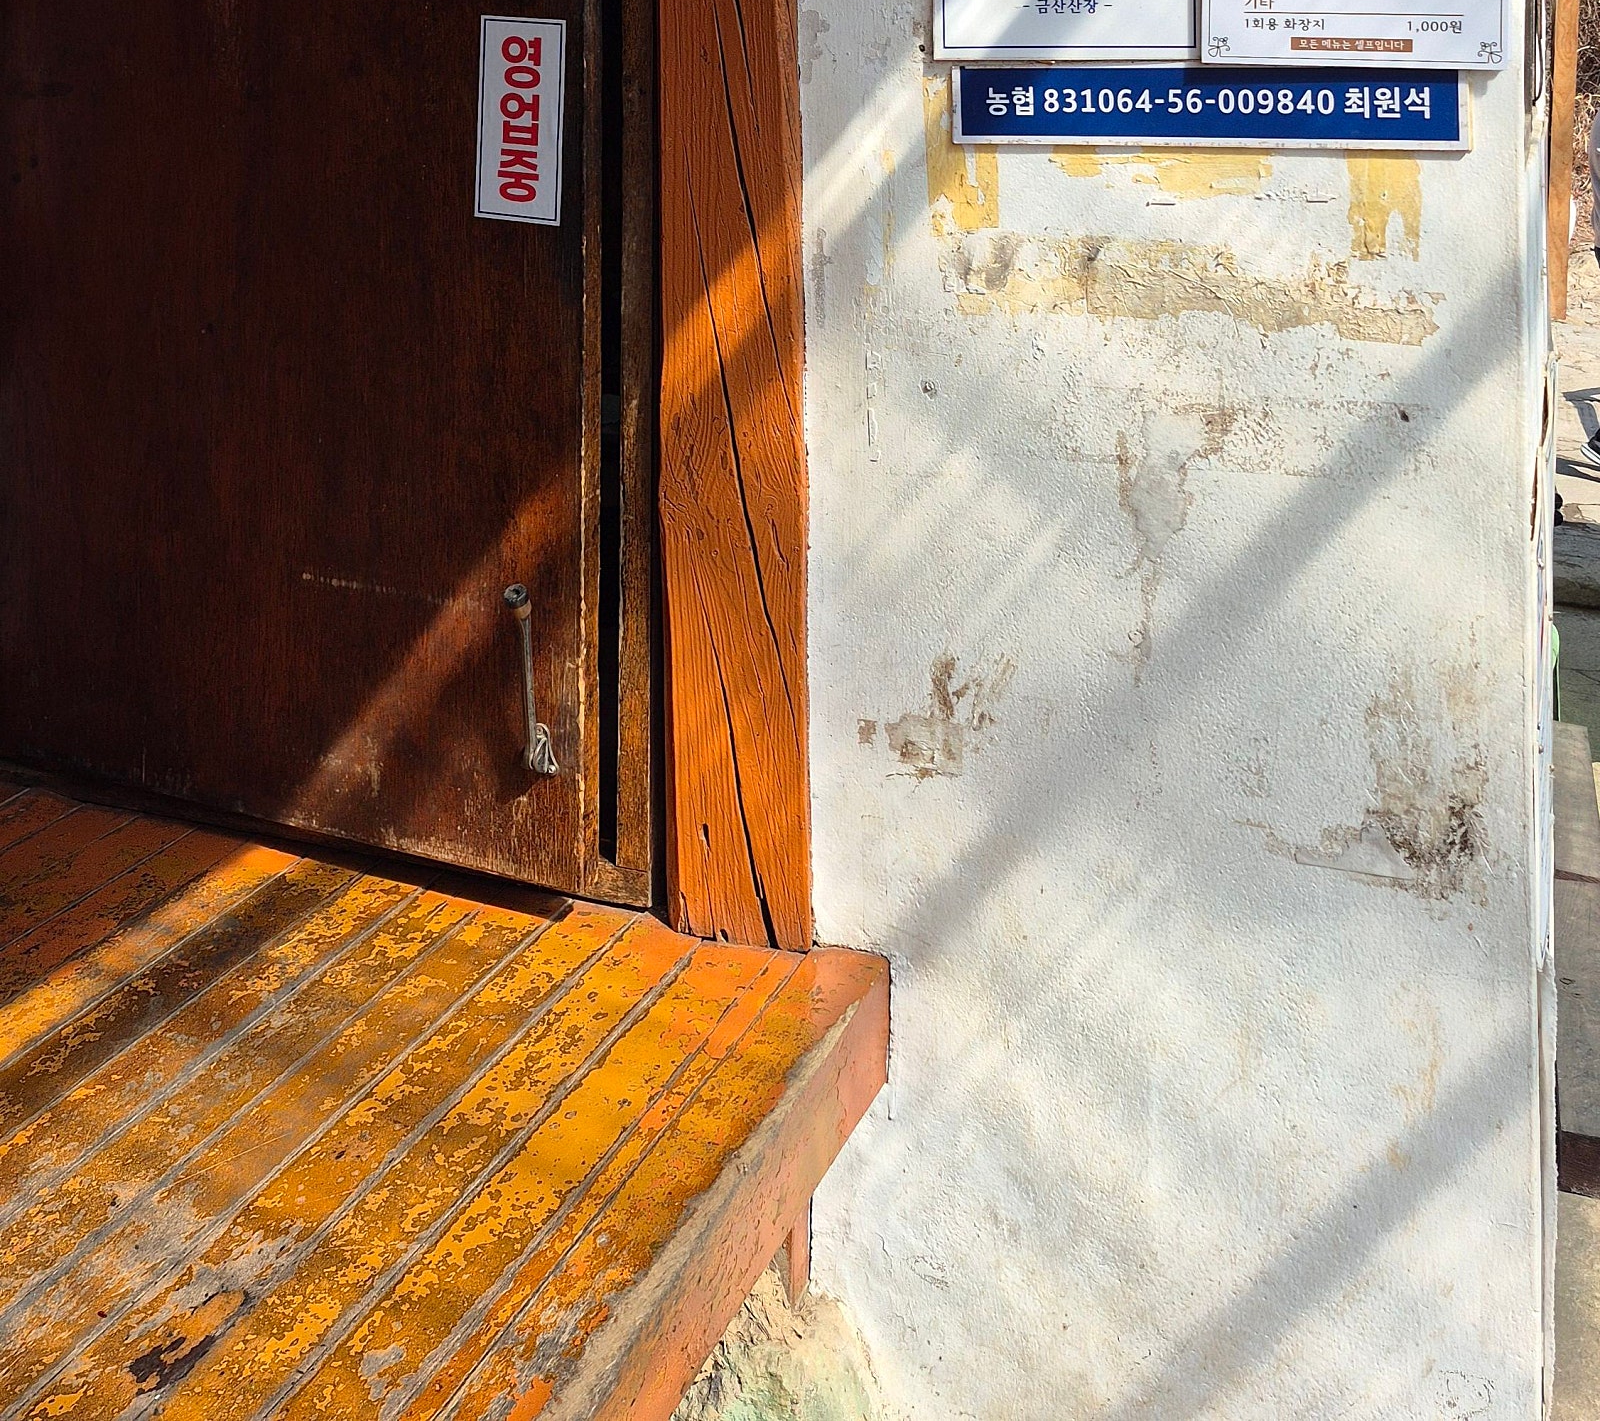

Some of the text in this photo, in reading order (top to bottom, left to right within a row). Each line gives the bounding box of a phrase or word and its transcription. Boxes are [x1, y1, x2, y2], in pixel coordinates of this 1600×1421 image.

[1244, 18, 1462, 34] 1회용 화장지 1,000원
[1299, 39, 1405, 51] 모든 메뉴는 셀프입니다
[985, 85, 1432, 120] 농협 831064-56-009840 최원석
[497, 35, 542, 204] 영업중
